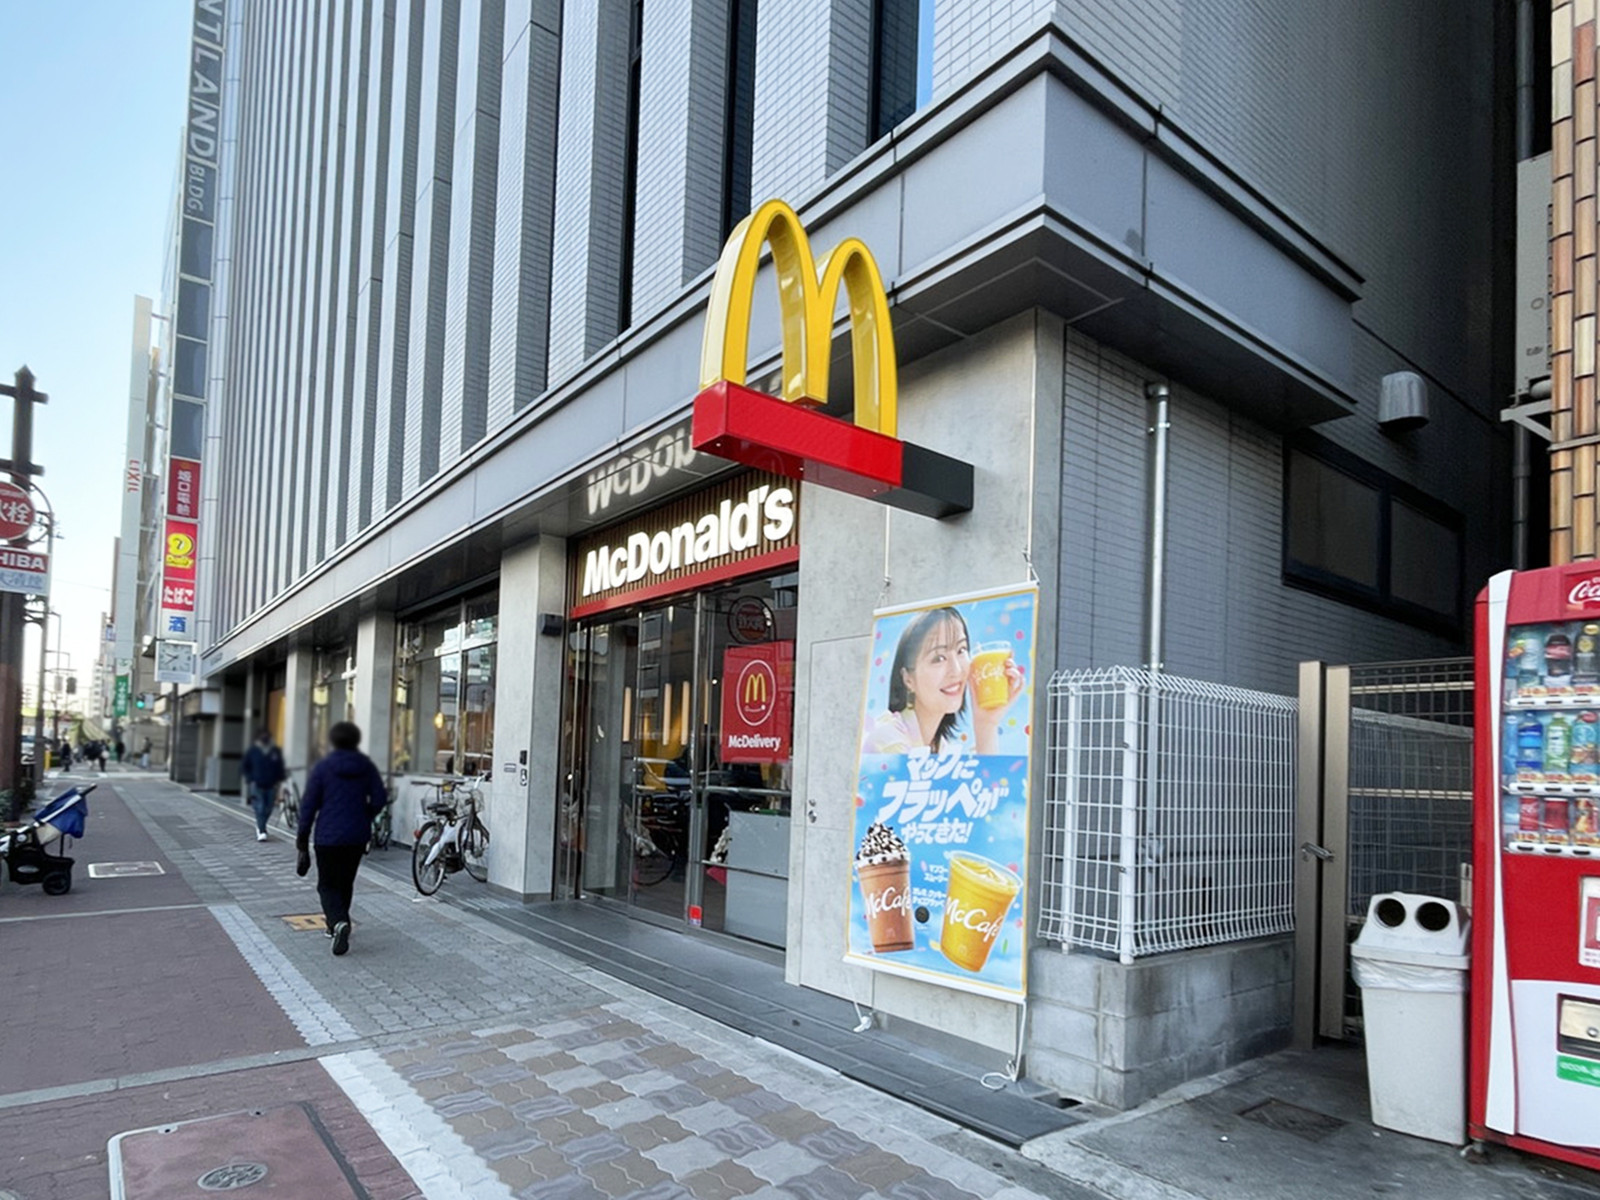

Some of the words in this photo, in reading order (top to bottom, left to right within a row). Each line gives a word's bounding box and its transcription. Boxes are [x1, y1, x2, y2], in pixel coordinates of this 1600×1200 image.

[127, 459, 141, 493] LIXIL
[582, 484, 794, 597] McDonald's
[163, 585, 194, 606] たばこ
[168, 615, 187, 633] 酒
[728, 734, 781, 752] McDelivery
[907, 745, 980, 781] マックに
[875, 778, 1009, 824] フラッペが
